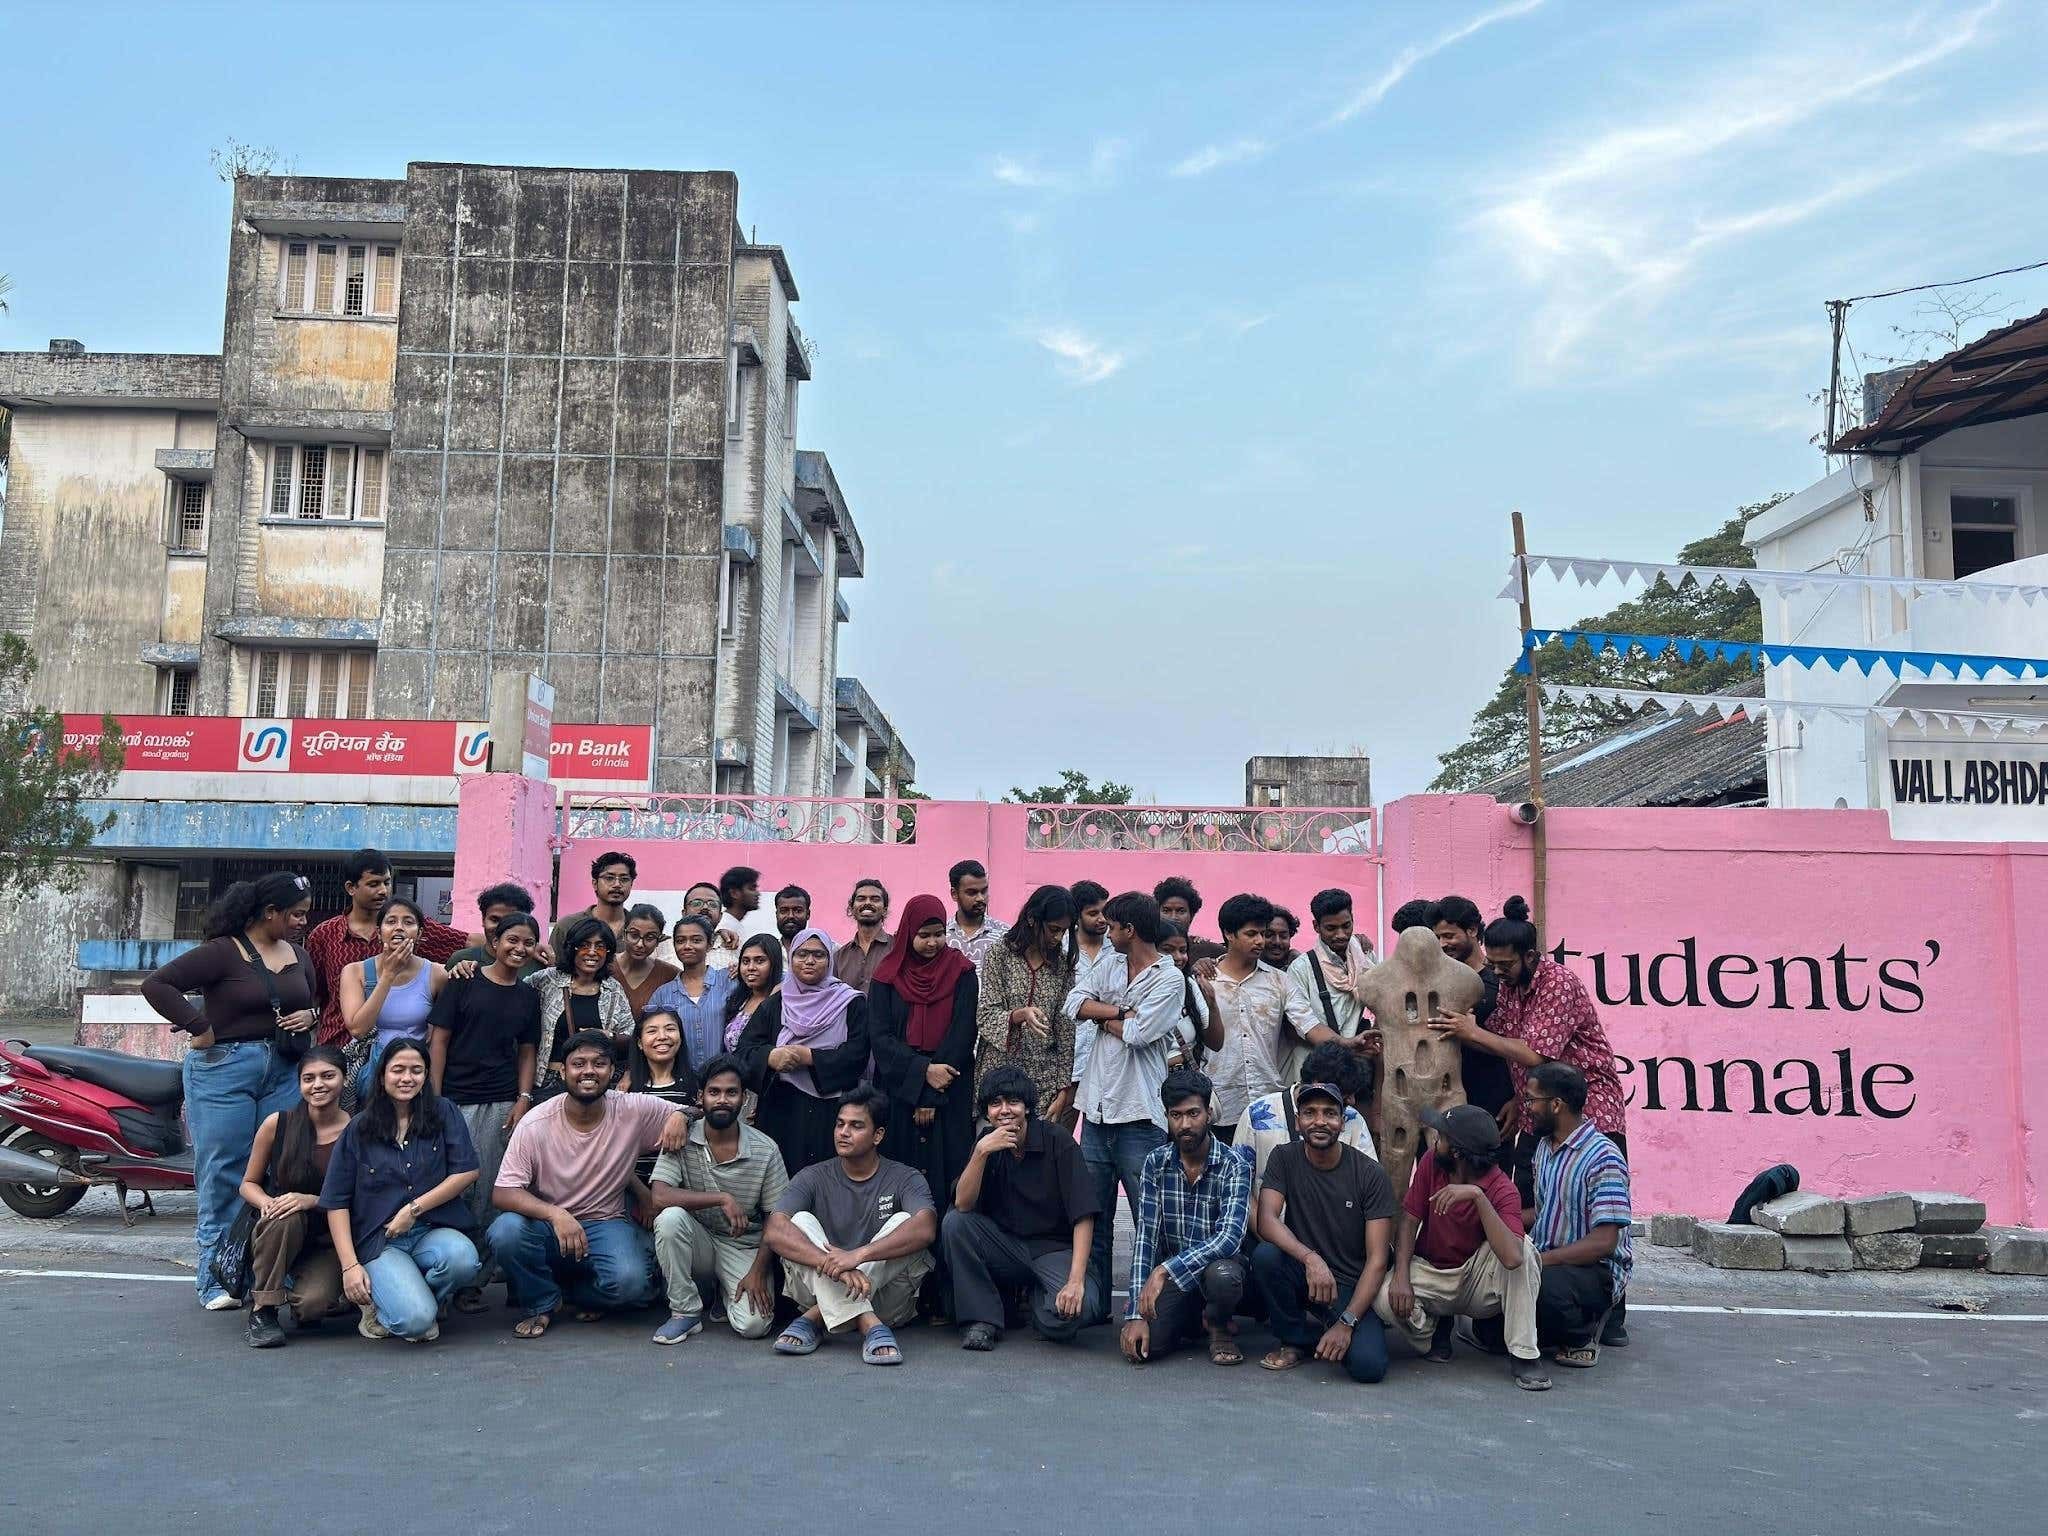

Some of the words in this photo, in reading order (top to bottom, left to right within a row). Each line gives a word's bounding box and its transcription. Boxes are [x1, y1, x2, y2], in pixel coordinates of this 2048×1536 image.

[302, 730, 372, 756] यूनियन
[374, 731, 407, 751] बैंक
[578, 739, 631, 756] Bank
[591, 757, 602, 767] of
[604, 758, 630, 768] India
[1547, 937, 1941, 1014] udents’
[1613, 1047, 1917, 1119] nnale
